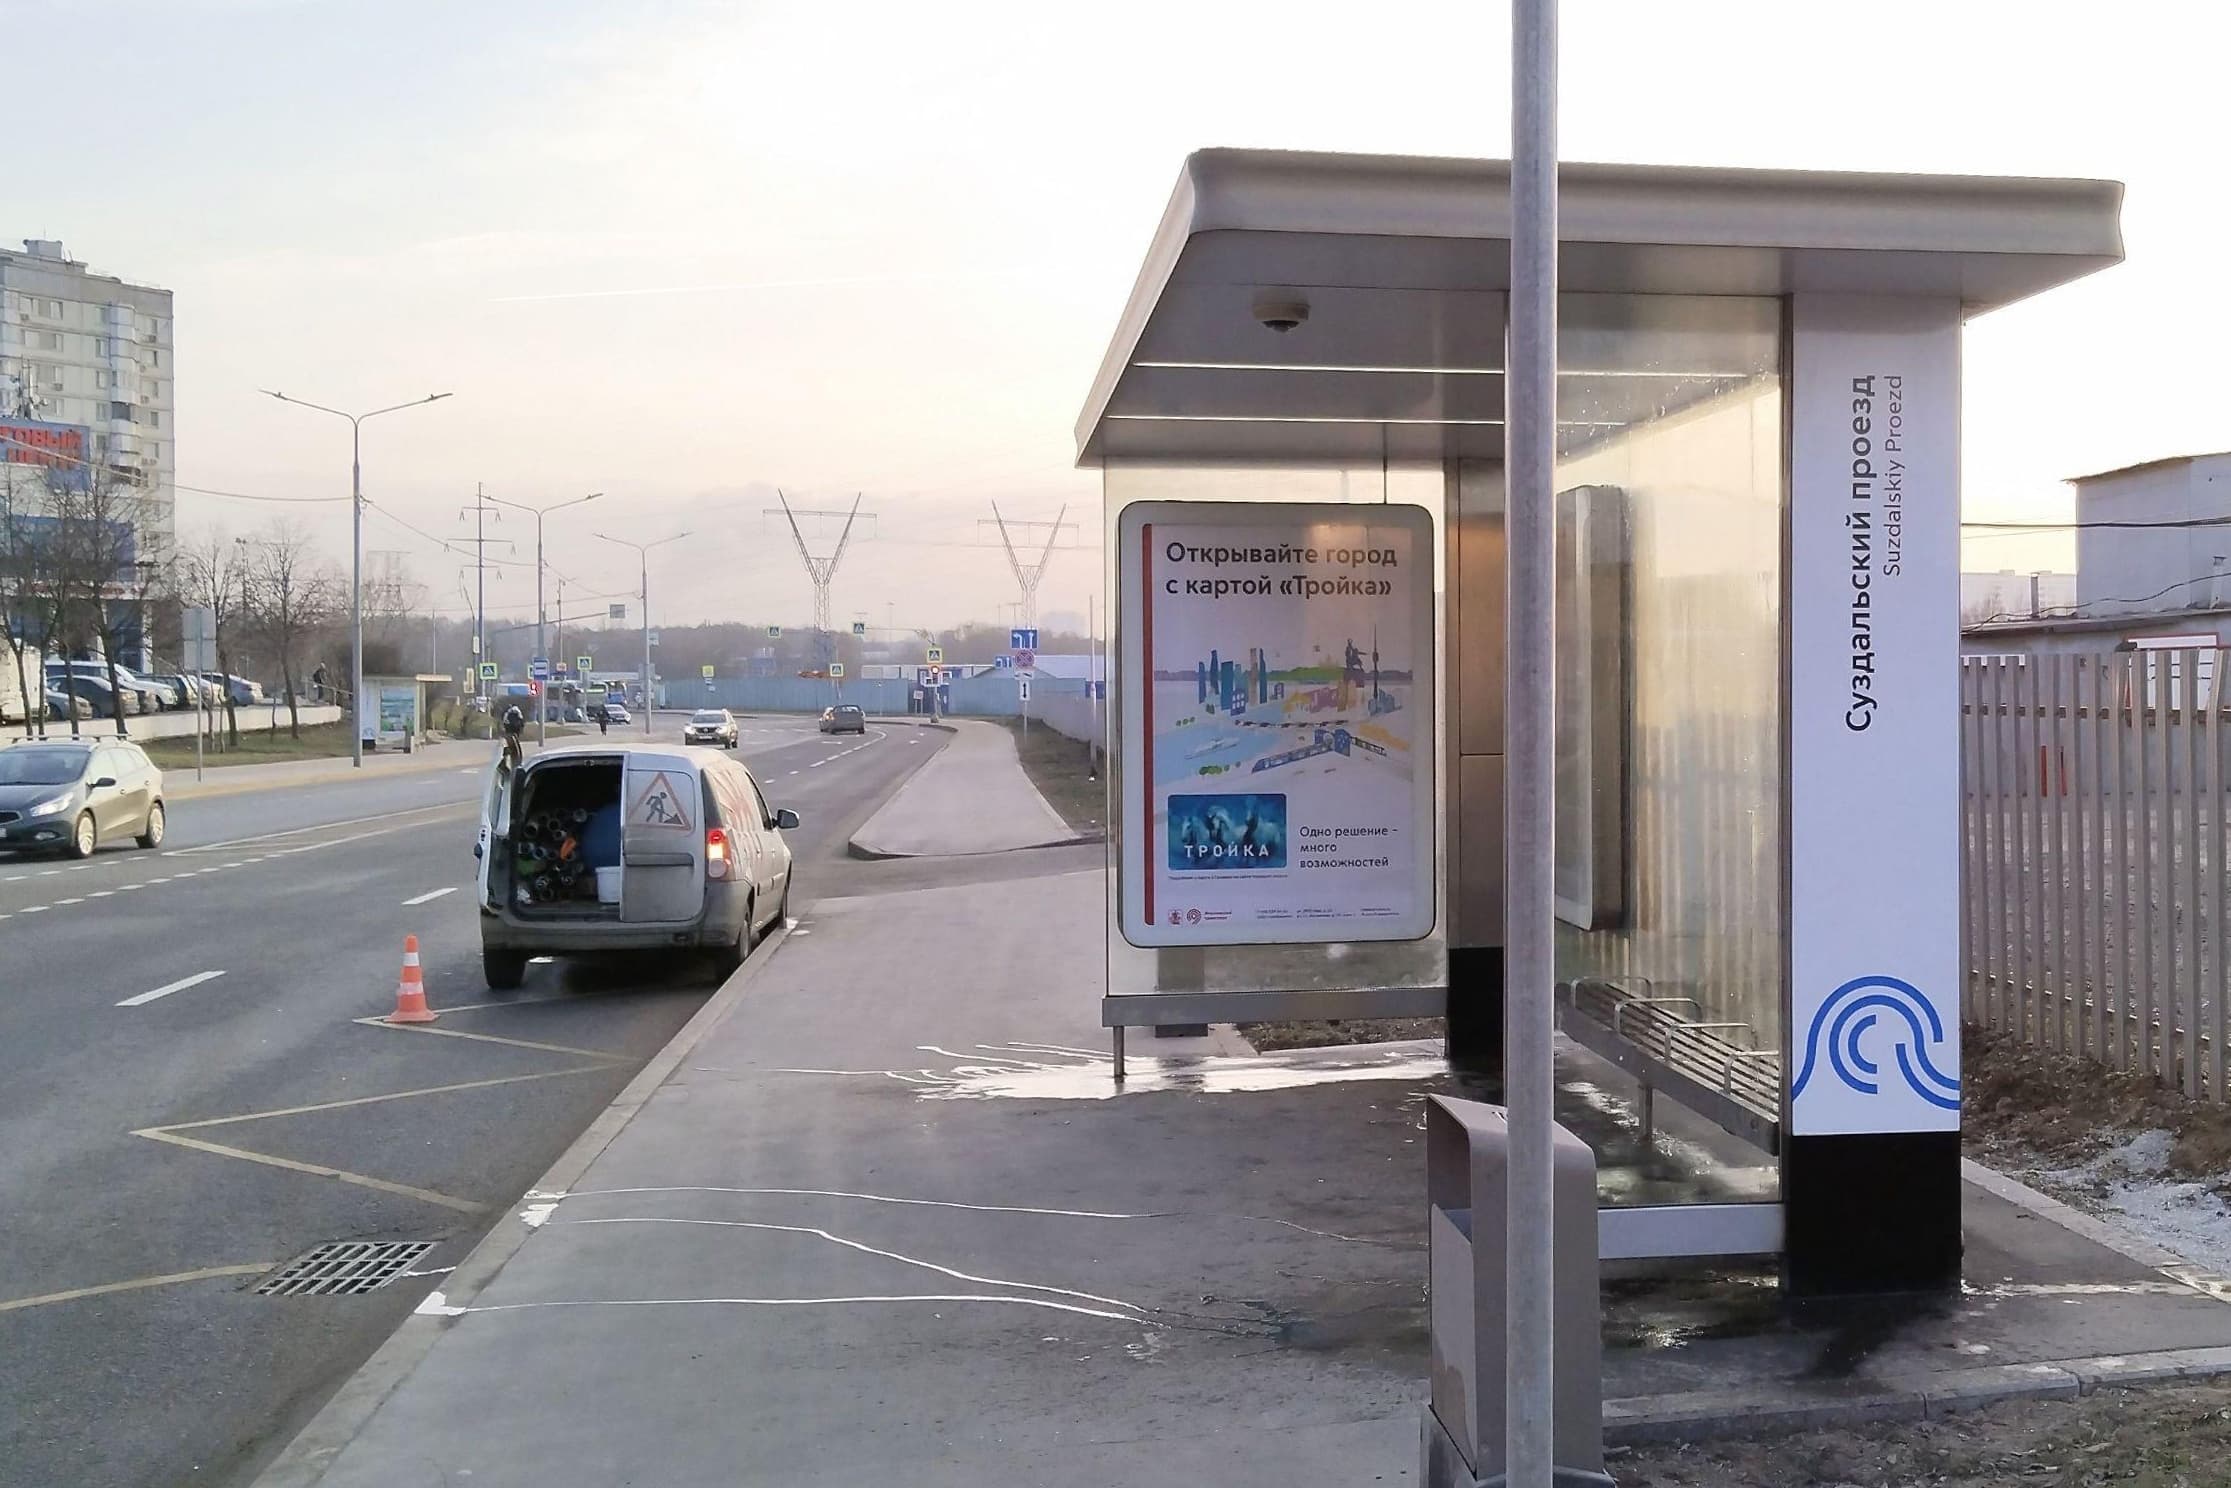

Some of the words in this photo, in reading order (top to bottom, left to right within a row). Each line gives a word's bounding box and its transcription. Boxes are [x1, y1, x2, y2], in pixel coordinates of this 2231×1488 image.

[1883, 375, 1902, 452] Proezd
[1852, 375, 1877, 500] проезд
[1883, 459, 1906, 577] Suzdalskiy
[1166, 542, 1318, 567] Открывайте
[1326, 548, 1398, 568] город
[1165, 579, 1179, 595] с
[1186, 576, 1272, 599] картой
[1279, 575, 1392, 600] «Тройка»
[1845, 512, 1878, 732] Суздальский
[1300, 826, 1332, 838] Одно
[1334, 827, 1389, 839] решение
[1184, 841, 1269, 858] ТРОЙКА
[1300, 843, 1337, 853] много
[1300, 856, 1389, 869] возможностей
